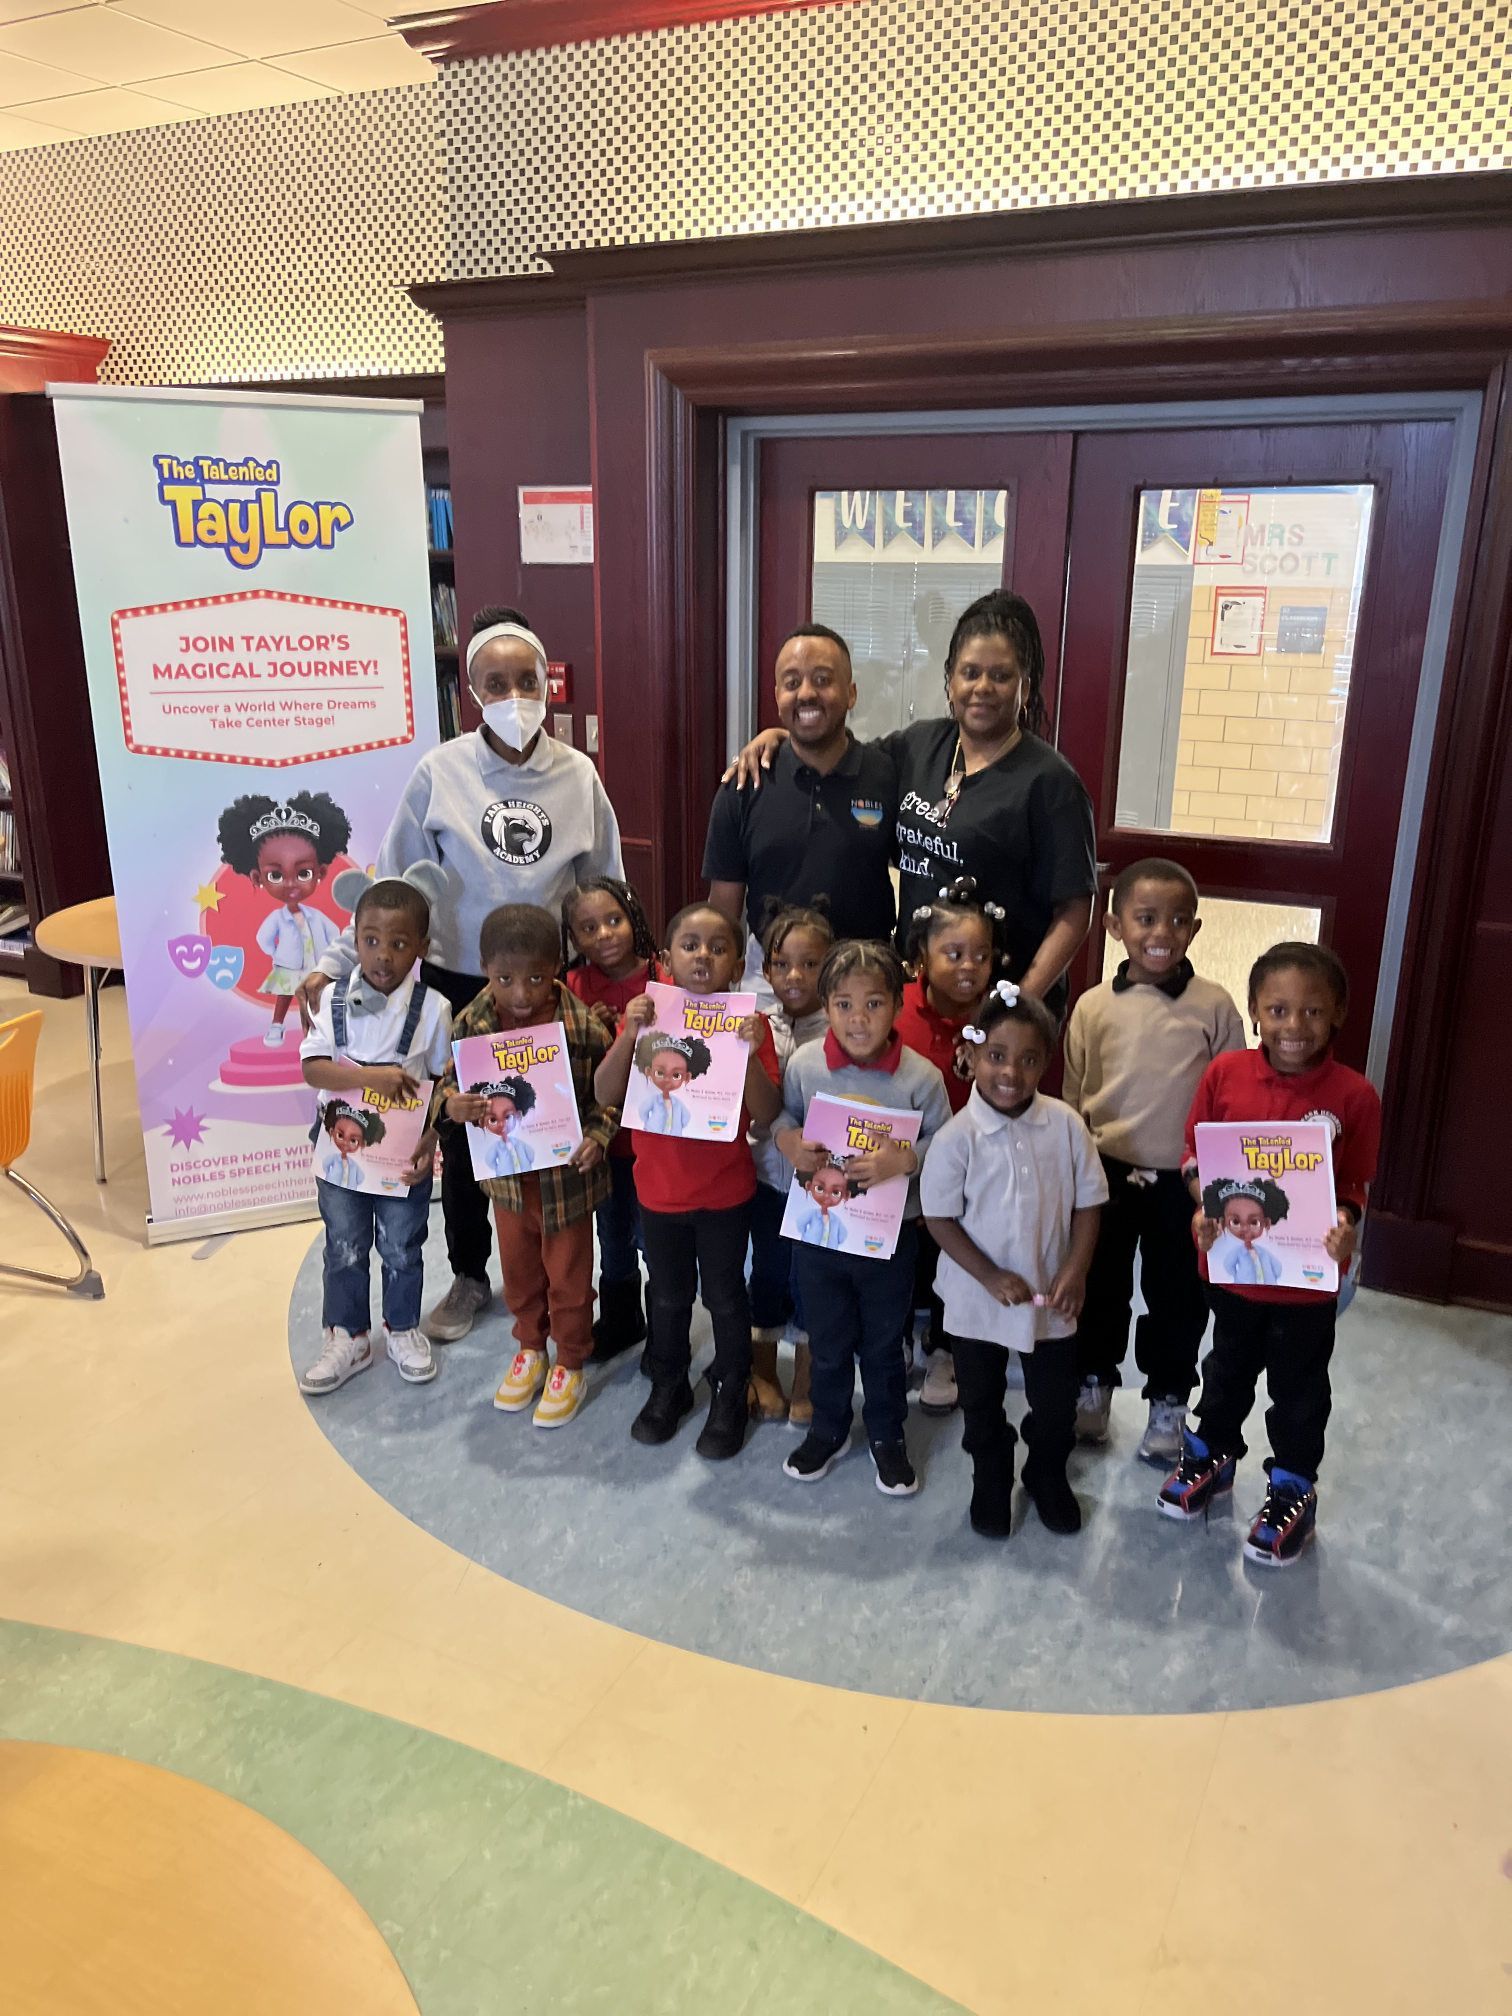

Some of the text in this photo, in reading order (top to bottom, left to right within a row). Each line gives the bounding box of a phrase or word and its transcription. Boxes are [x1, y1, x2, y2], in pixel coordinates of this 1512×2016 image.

[155, 456, 196, 481] The
[1243, 523, 1304, 546] MRS
[1241, 552, 1339, 576] SCOTT
[179, 635, 235, 653] JOIN
[152, 659, 379, 680] MAGICAL JOURNEY!
[162, 698, 377, 715] Uncover a World Where Dreams
[210, 715, 335, 729] Take Center Stage!
[484, 801, 550, 827] PARK HEIGHTS
[493, 847, 541, 864] ACADEMY
[1241, 1136, 1257, 1146] The
[170, 1155, 239, 1173] DISCOVER
[243, 1149, 281, 1163] MORE
[171, 1170, 226, 1187] NOBLES
[229, 1163, 281, 1178] SPEECH
[173, 1176, 315, 1205] www.noblesspeechthera
[174, 1188, 317, 1217] info@noblesspeechthera
